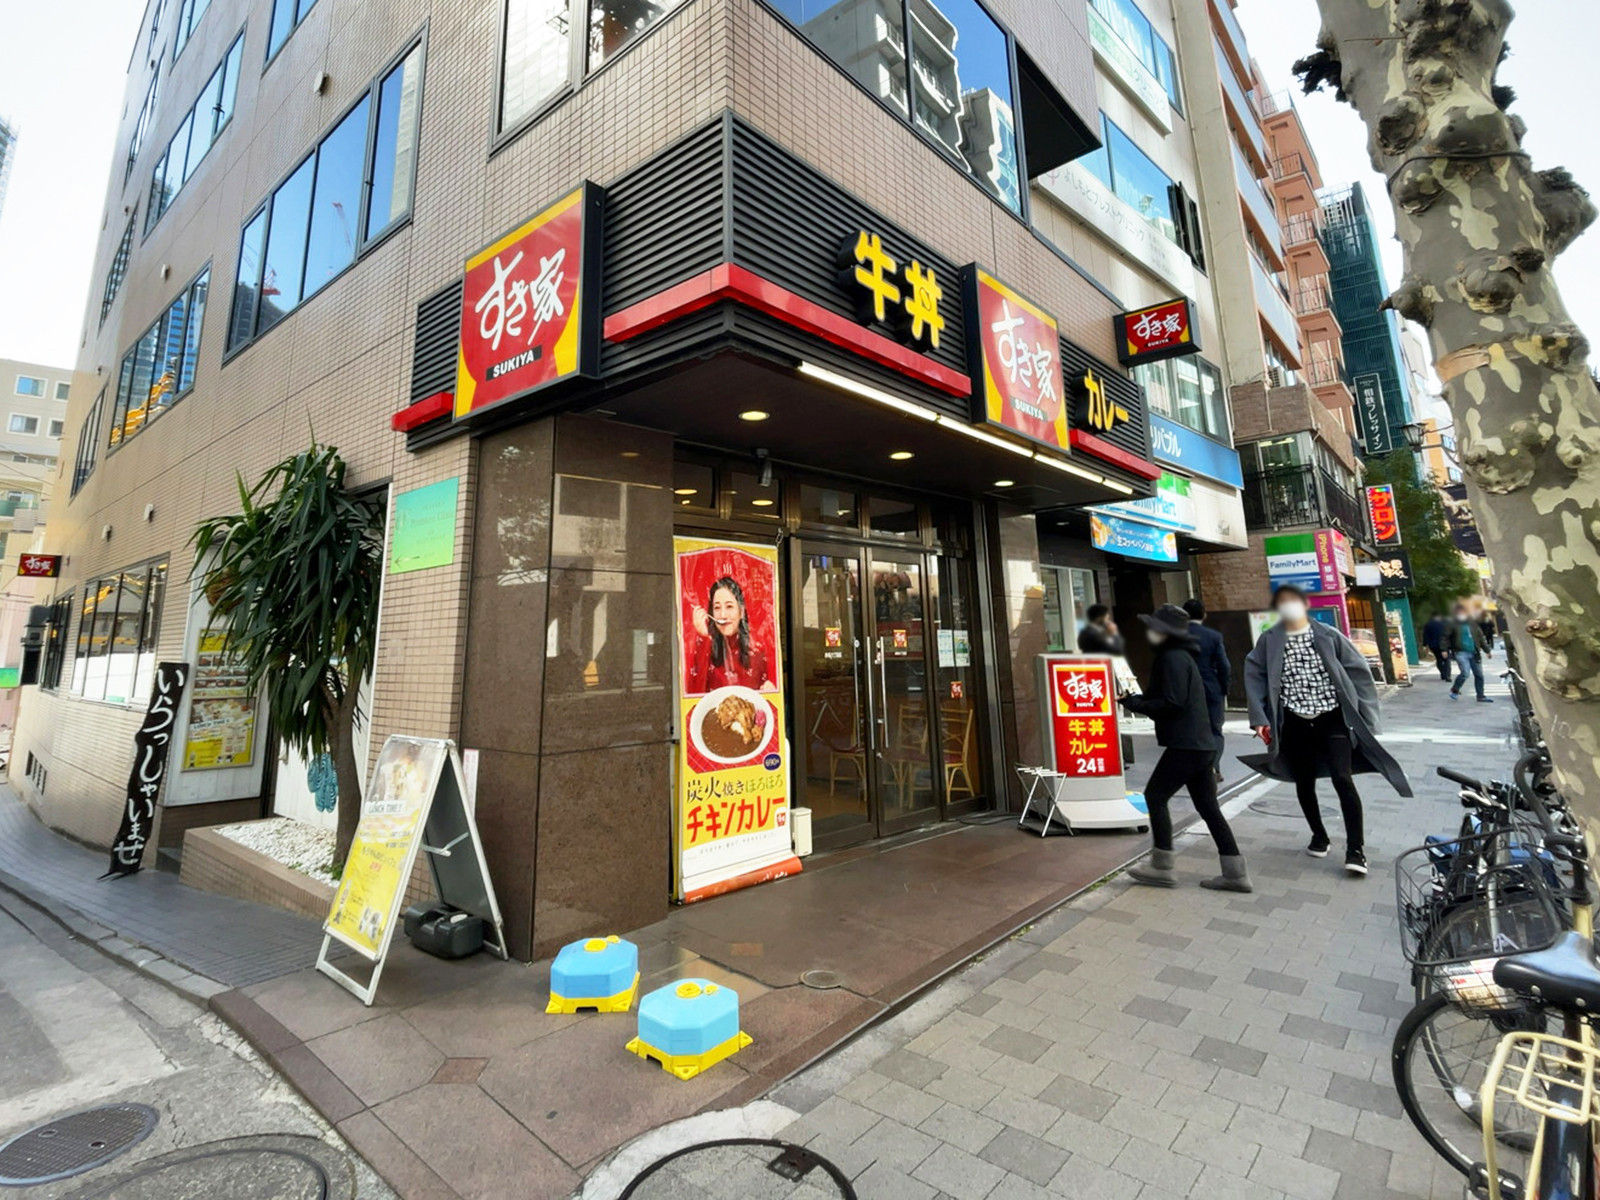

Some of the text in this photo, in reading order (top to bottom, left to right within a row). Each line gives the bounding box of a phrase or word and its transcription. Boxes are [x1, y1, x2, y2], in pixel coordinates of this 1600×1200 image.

[475, 248, 566, 351] すき家
[854, 230, 945, 349] 牛丼
[1132, 312, 1182, 340] すき家
[492, 349, 534, 378] SUKIYA
[991, 298, 1057, 404] すき家
[1014, 399, 1044, 421] SUKIYA
[1084, 367, 1129, 431] カレー
[1149, 424, 1182, 458] リバブル
[1317, 533, 1330, 564] iPhone
[1269, 559, 1317, 570] FamilyMart
[1063, 671, 1104, 702] すき家
[1068, 718, 1106, 737] 牛丼
[1068, 737, 1108, 756] カレー
[113, 668, 185, 866] いらっしゃいませ
[686, 773, 784, 803] 炭火焼きほろほろ
[686, 795, 786, 844] チキンカレー
